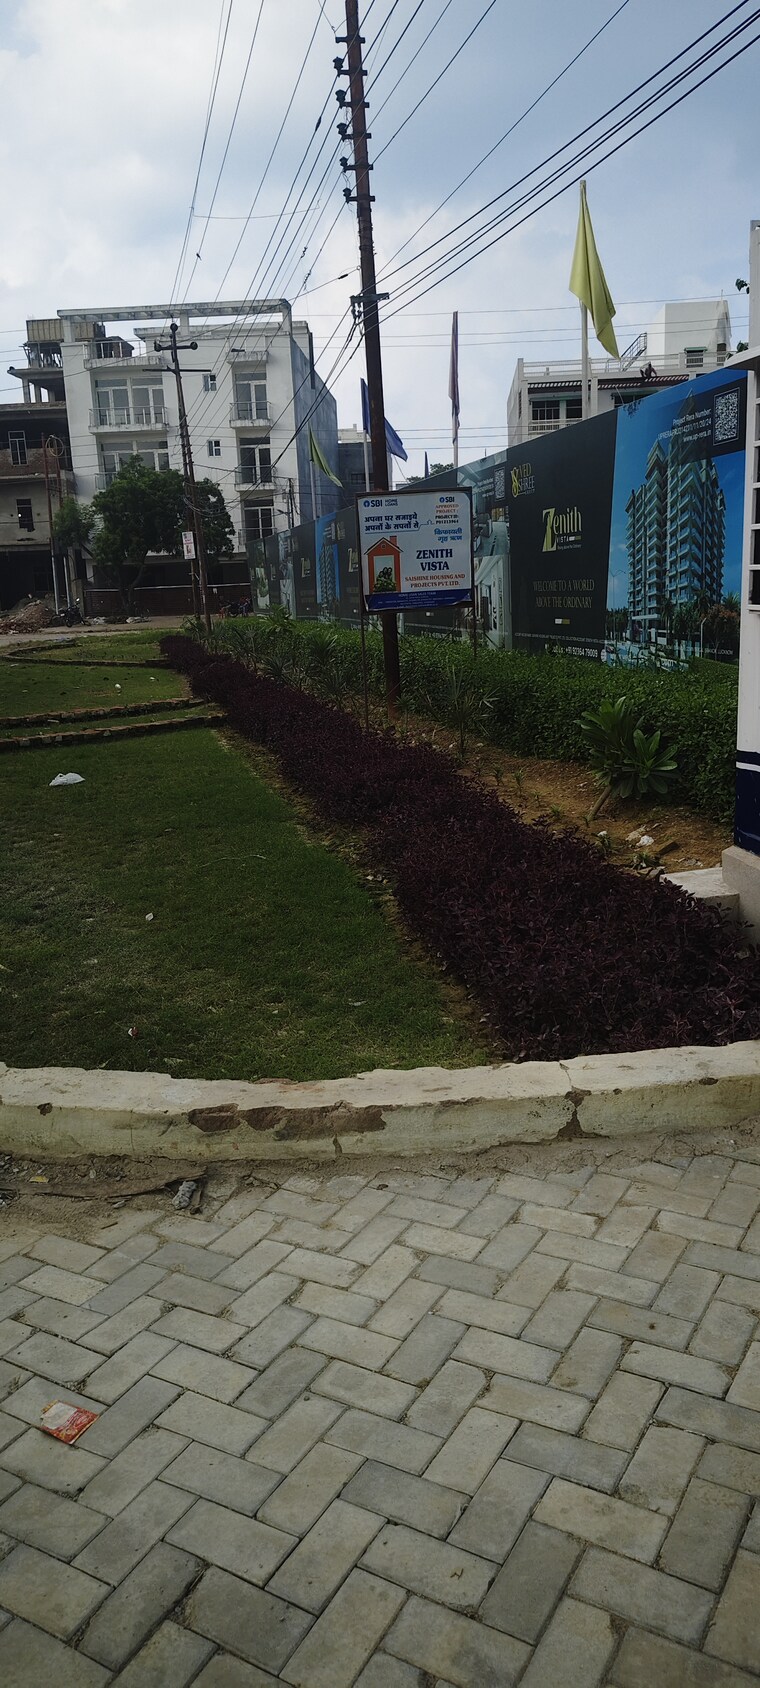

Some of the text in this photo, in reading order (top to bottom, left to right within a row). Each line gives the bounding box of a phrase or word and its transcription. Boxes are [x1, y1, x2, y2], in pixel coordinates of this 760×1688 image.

[518, 475, 536, 492] SHREE
[371, 499, 383, 507] SBI
[365, 521, 419, 532] अपनों के सपनों से
[542, 506, 582, 553] Zenith
[416, 548, 453, 560] ZENITH
[420, 561, 450, 572] VISTA
[533, 580, 557, 592] WELCOME
[558, 580, 567, 591] TO
[572, 579, 595, 591] WORLD
[536, 596, 593, 608] ABOVE THE ORDINARY
